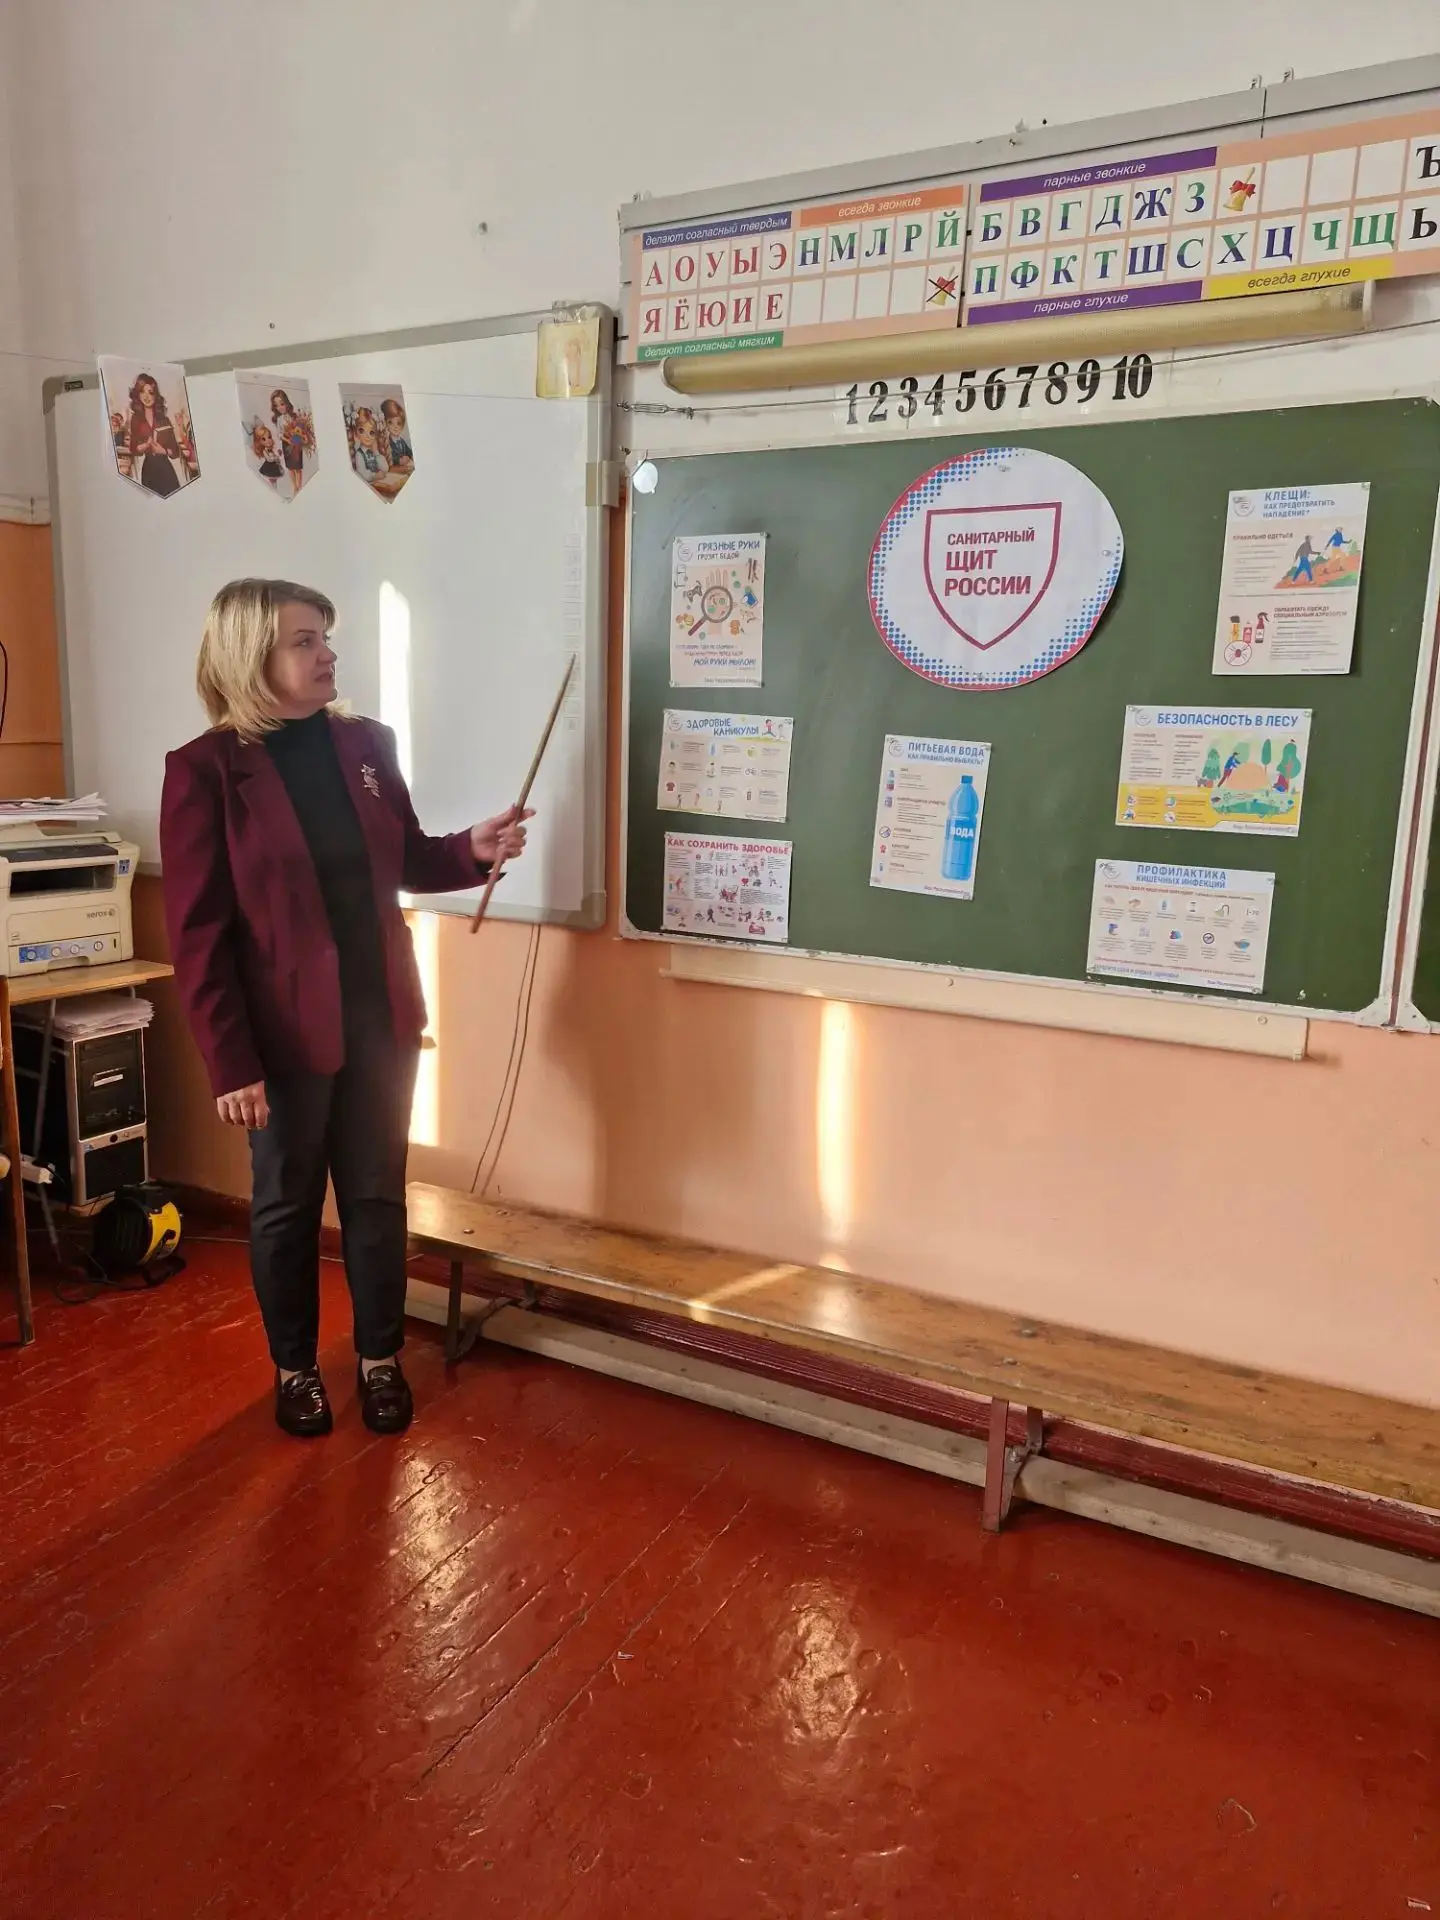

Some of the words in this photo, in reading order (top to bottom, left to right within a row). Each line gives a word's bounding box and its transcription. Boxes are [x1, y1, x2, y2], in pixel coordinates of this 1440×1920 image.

[1043, 172, 1091, 188] парные
[1095, 162, 1146, 181] звонкие
[838, 203, 875, 218] всегда
[878, 197, 922, 211] звонкие
[981, 213, 1002, 242] Б
[1019, 207, 1041, 237] В
[1058, 200, 1081, 231] Г
[1095, 195, 1122, 232] Д
[1134, 186, 1172, 220] Ж
[1185, 182, 1206, 213] З
[645, 233, 684, 246] делают
[685, 223, 737, 242] согласный
[740, 217, 788, 233] твердым
[645, 261, 663, 287] А
[675, 255, 695, 281] О
[706, 250, 724, 278] У
[732, 246, 759, 275] Ы
[768, 242, 787, 270] Э
[798, 237, 821, 266] Н
[830, 231, 857, 262] М
[865, 227, 890, 257] Л
[904, 223, 922, 252] Р
[936, 210, 961, 248] Й
[975, 264, 1000, 295] П
[1010, 259, 1039, 289] Ф
[1050, 254, 1077, 285] К
[1094, 249, 1118, 280] Т
[1127, 242, 1167, 275] Ш
[1177, 238, 1205, 268] С
[1218, 231, 1248, 264] Х
[1263, 225, 1296, 263] Ц
[1312, 219, 1342, 250] Ч
[1350, 211, 1398, 250] Щ
[1409, 207, 1438, 240] Ь
[1248, 270, 1297, 289] всегда
[1301, 266, 1351, 285] глухие
[1033, 297, 1081, 314] парные
[1085, 293, 1129, 310] глухие
[643, 307, 663, 334] Я
[673, 298, 690, 331] Ё
[698, 301, 726, 328] Ю
[732, 297, 753, 324] И
[766, 293, 783, 320] Е
[644, 346, 682, 358] делают
[684, 340, 737, 355] согласный
[738, 336, 775, 349] мягким
[846, 383, 859, 425] 1
[868, 381, 889, 422] 2
[898, 377, 919, 420] 3
[924, 374, 946, 417] 4
[955, 369, 977, 413] 5
[983, 367, 1006, 411] 6
[1015, 365, 1039, 409] 7
[1045, 361, 1070, 405] 8
[1076, 359, 1101, 403] 9
[1112, 353, 1153, 401] 10
[1265, 490, 1311, 502] КЛЕЩИ:
[1278, 500, 1335, 509] ПРЕДОТВРАТИТЬ
[1263, 510, 1310, 519] НАПАДЕНИЕ?
[698, 541, 736, 551] ГРЯЗНЫЕ
[738, 540, 760, 550] РУКИ
[946, 527, 1035, 547] САНИТАРНЫЙ
[719, 551, 739, 560] БЕДОЙ
[945, 550, 998, 573] ЩИТ
[944, 575, 1032, 597] РОССИИ
[687, 718, 731, 730] ЗДОРОВЫЕ
[1157, 713, 1253, 728] БЕЗОПАСНОСТЬ
[1255, 715, 1263, 726] В
[1264, 715, 1299, 728] ЛЕСУ
[714, 726, 759, 737] КАНИКУЛЫ
[908, 742, 957, 755] ПИТЬЕВАЯ
[958, 746, 985, 757] ВОДА
[950, 826, 975, 838] ВОДА
[667, 838, 685, 848] КАК
[688, 840, 739, 851] СОХРАНИТЬ
[742, 844, 789, 855] ЗДОРОВЬЕ
[1137, 864, 1227, 880] ПРОФИЛАКТИКА
[1136, 874, 1179, 885] КИШЕЧНЫХ
[1181, 878, 1226, 889] ИНФЕКЦИЙ
[86, 911, 107, 919] xerox
